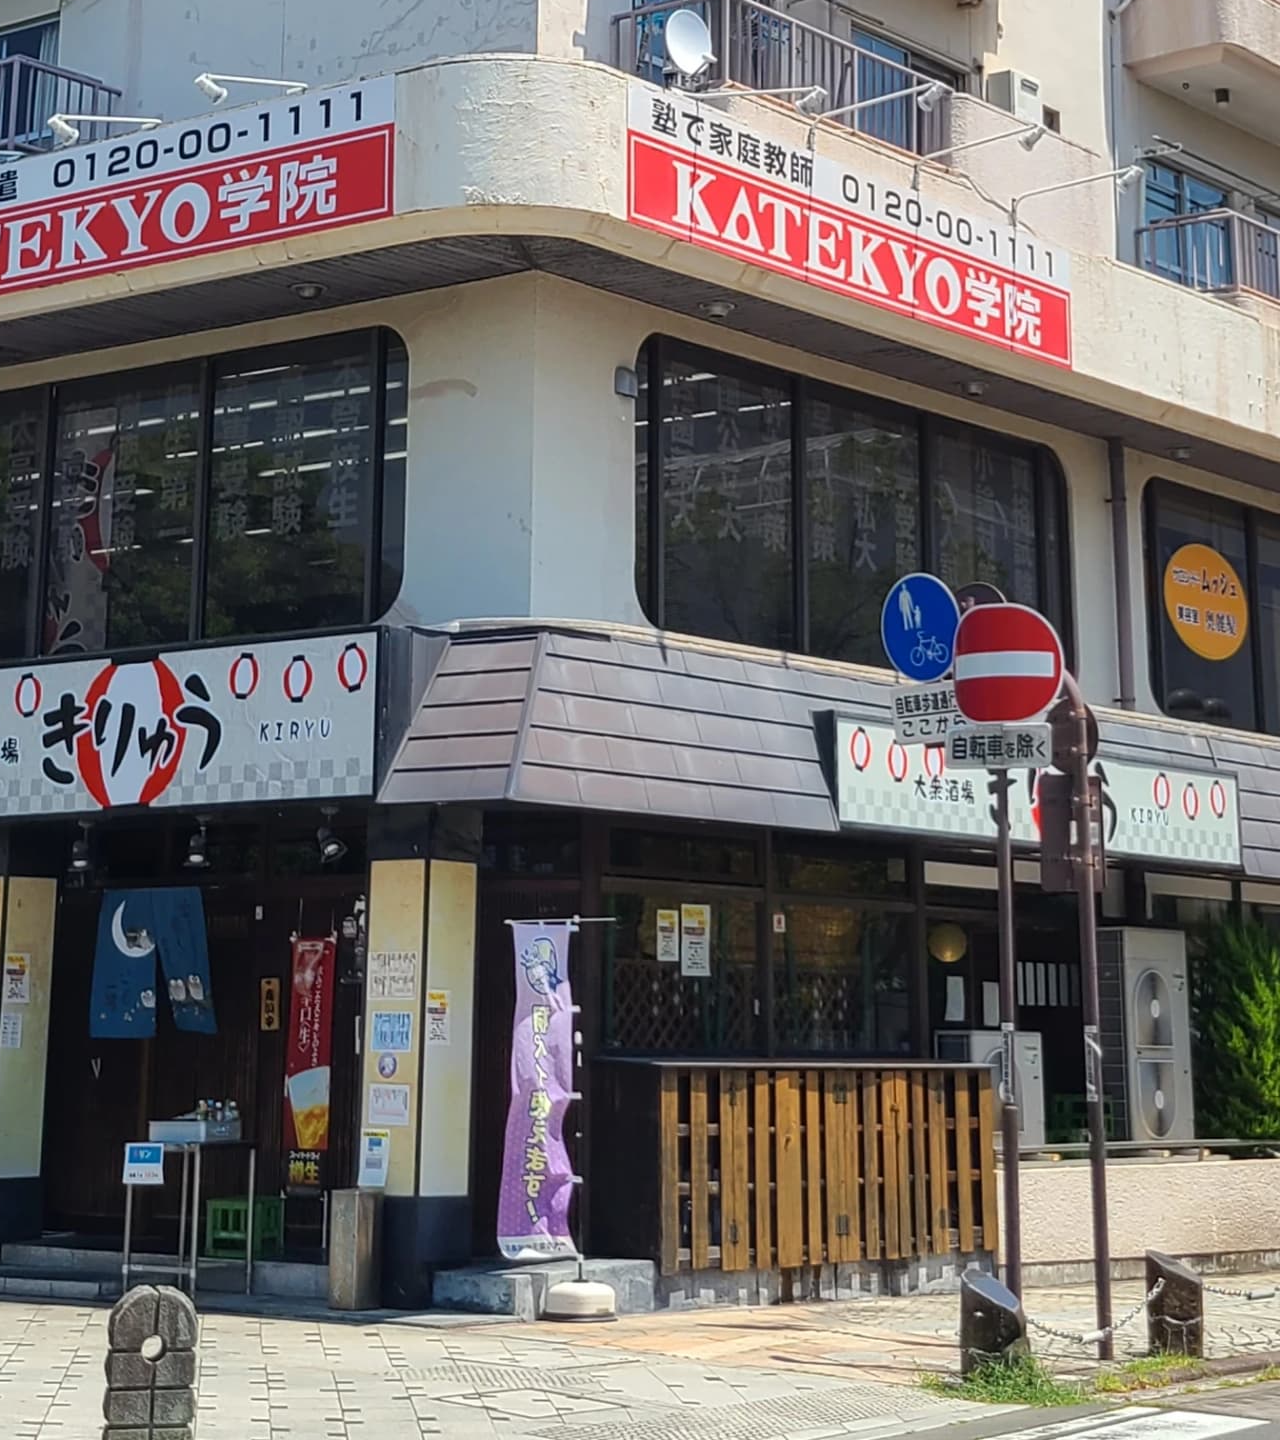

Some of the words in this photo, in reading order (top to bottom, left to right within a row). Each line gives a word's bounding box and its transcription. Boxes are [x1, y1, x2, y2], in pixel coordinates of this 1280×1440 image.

[53, 91, 364, 188] 0120-00-1111
[650, 98, 814, 188] 塾で家庭教師
[842, 173, 1054, 278] 0120-00-1111
[671, 160, 1042, 347] KATEKYO学院
[41, 673, 222, 785] きりゅう
[259, 719, 332, 743] KIRYU
[952, 733, 1046, 760] 自転車を除く
[913, 774, 975, 805] 大衆酒場
[1130, 807, 1170, 826] KIRYU
